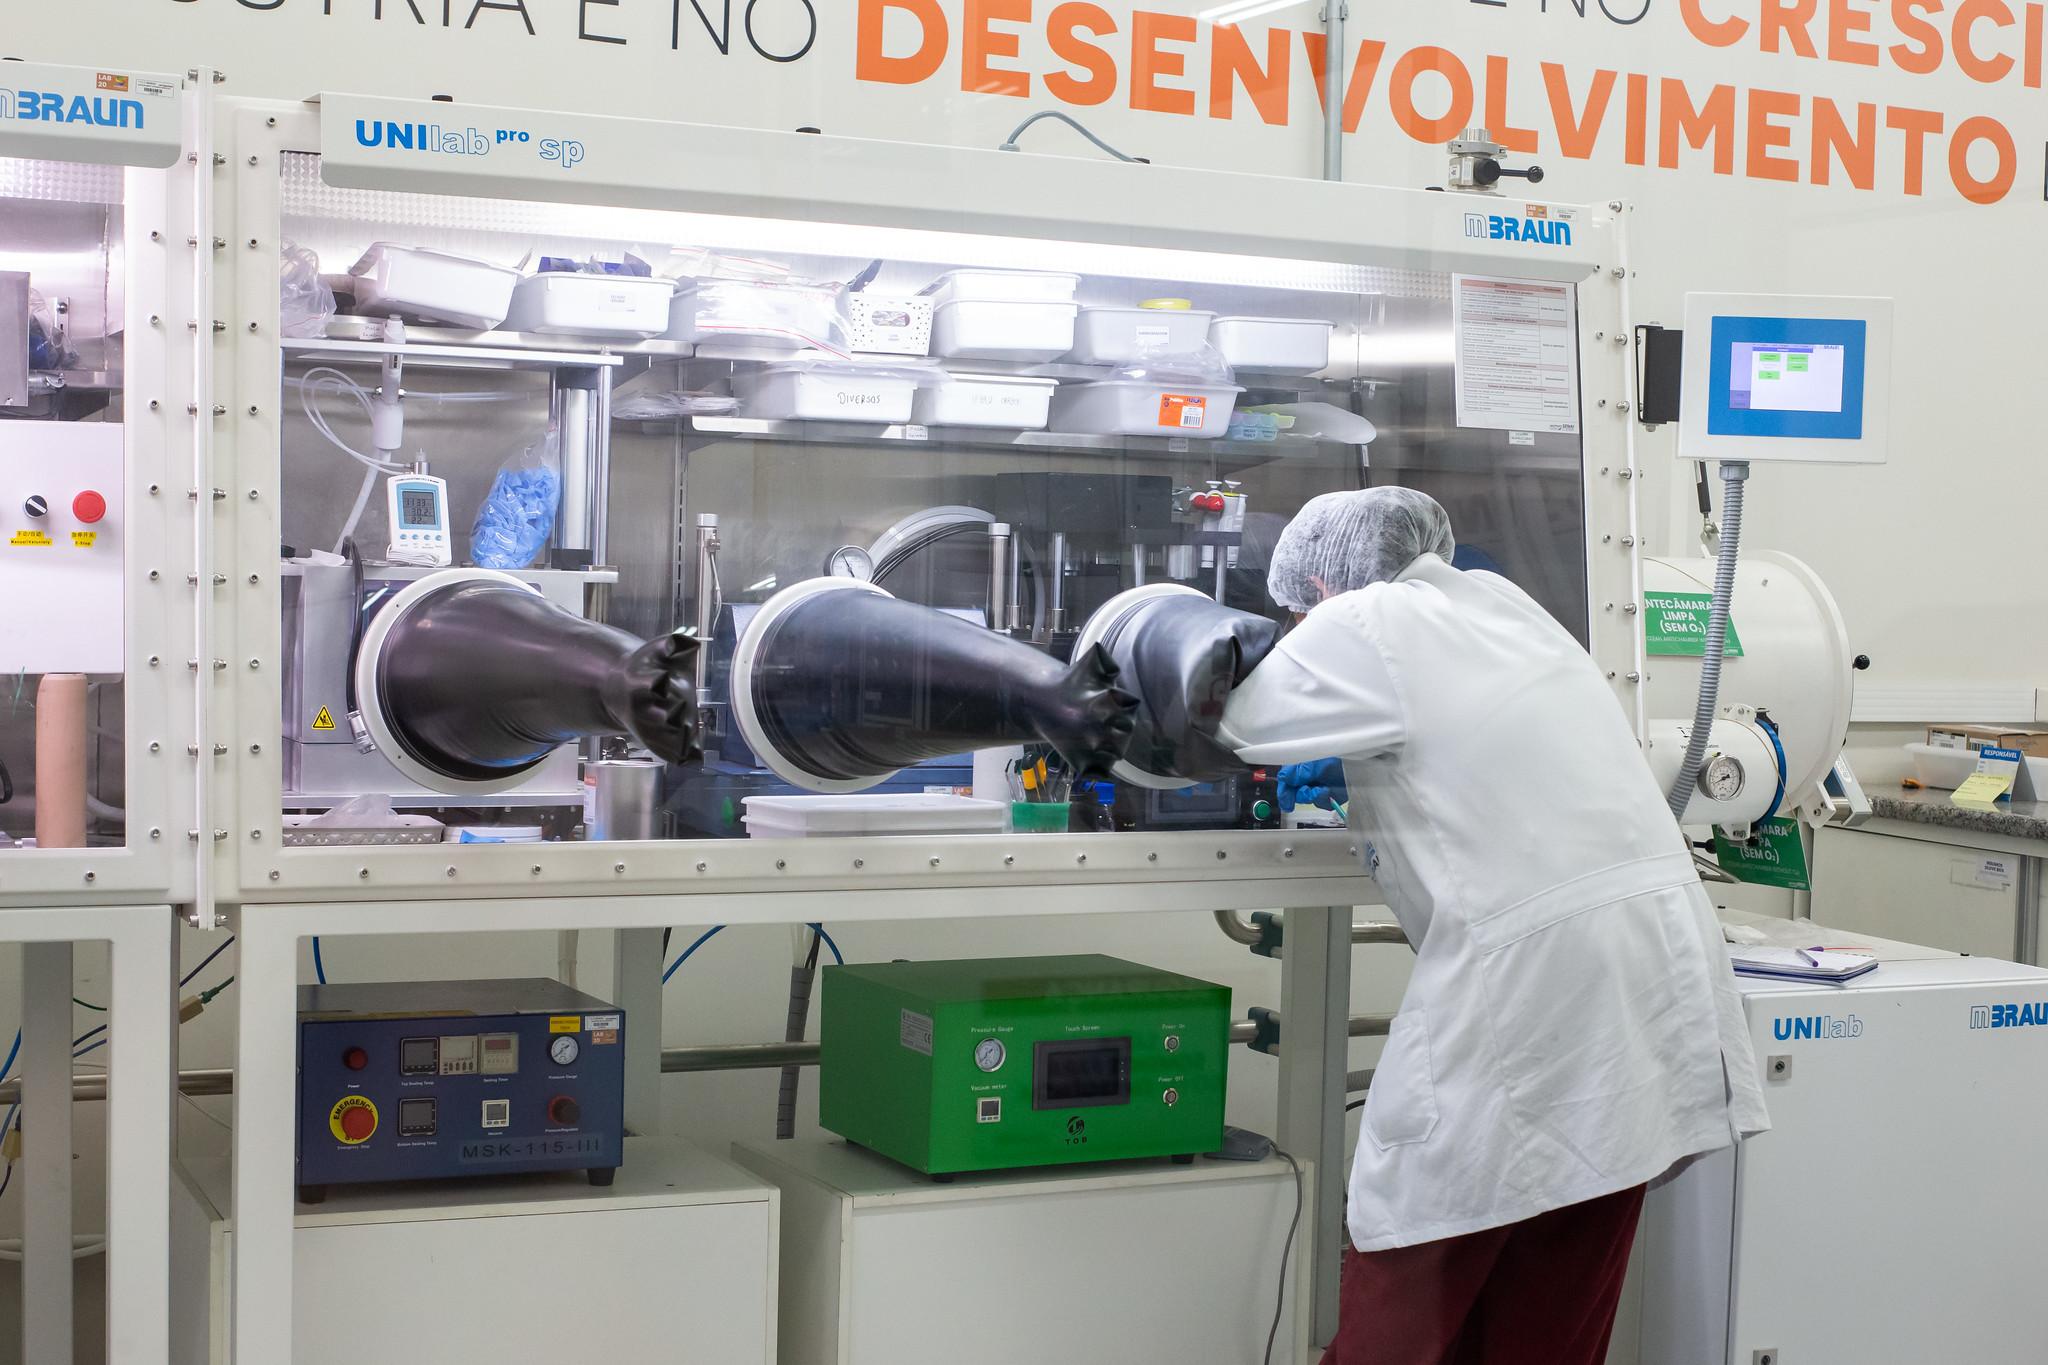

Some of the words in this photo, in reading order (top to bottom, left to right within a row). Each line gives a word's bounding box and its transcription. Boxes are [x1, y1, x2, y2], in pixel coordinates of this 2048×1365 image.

[672, 0, 817, 63] NO
[856, 0, 2017, 205] DESENVOLVIMENTO
[355, 119, 490, 156] UNIlab
[496, 129, 531, 144] pro
[539, 138, 585, 168] sp
[837, 391, 881, 405] DIVERSOS
[1645, 598, 1713, 611] NTECÂMARA
[1663, 611, 1697, 622] LIMPA
[1660, 619, 1688, 634] (SEM
[1984, 749, 2017, 759] RESPONSÁVEL
[1740, 847, 1763, 861] (SEM
[1773, 1015, 1864, 1040] UNIlab
[334, 1099, 374, 1120] EMERGENCY
[463, 1138, 599, 1159] MSK-115-III
